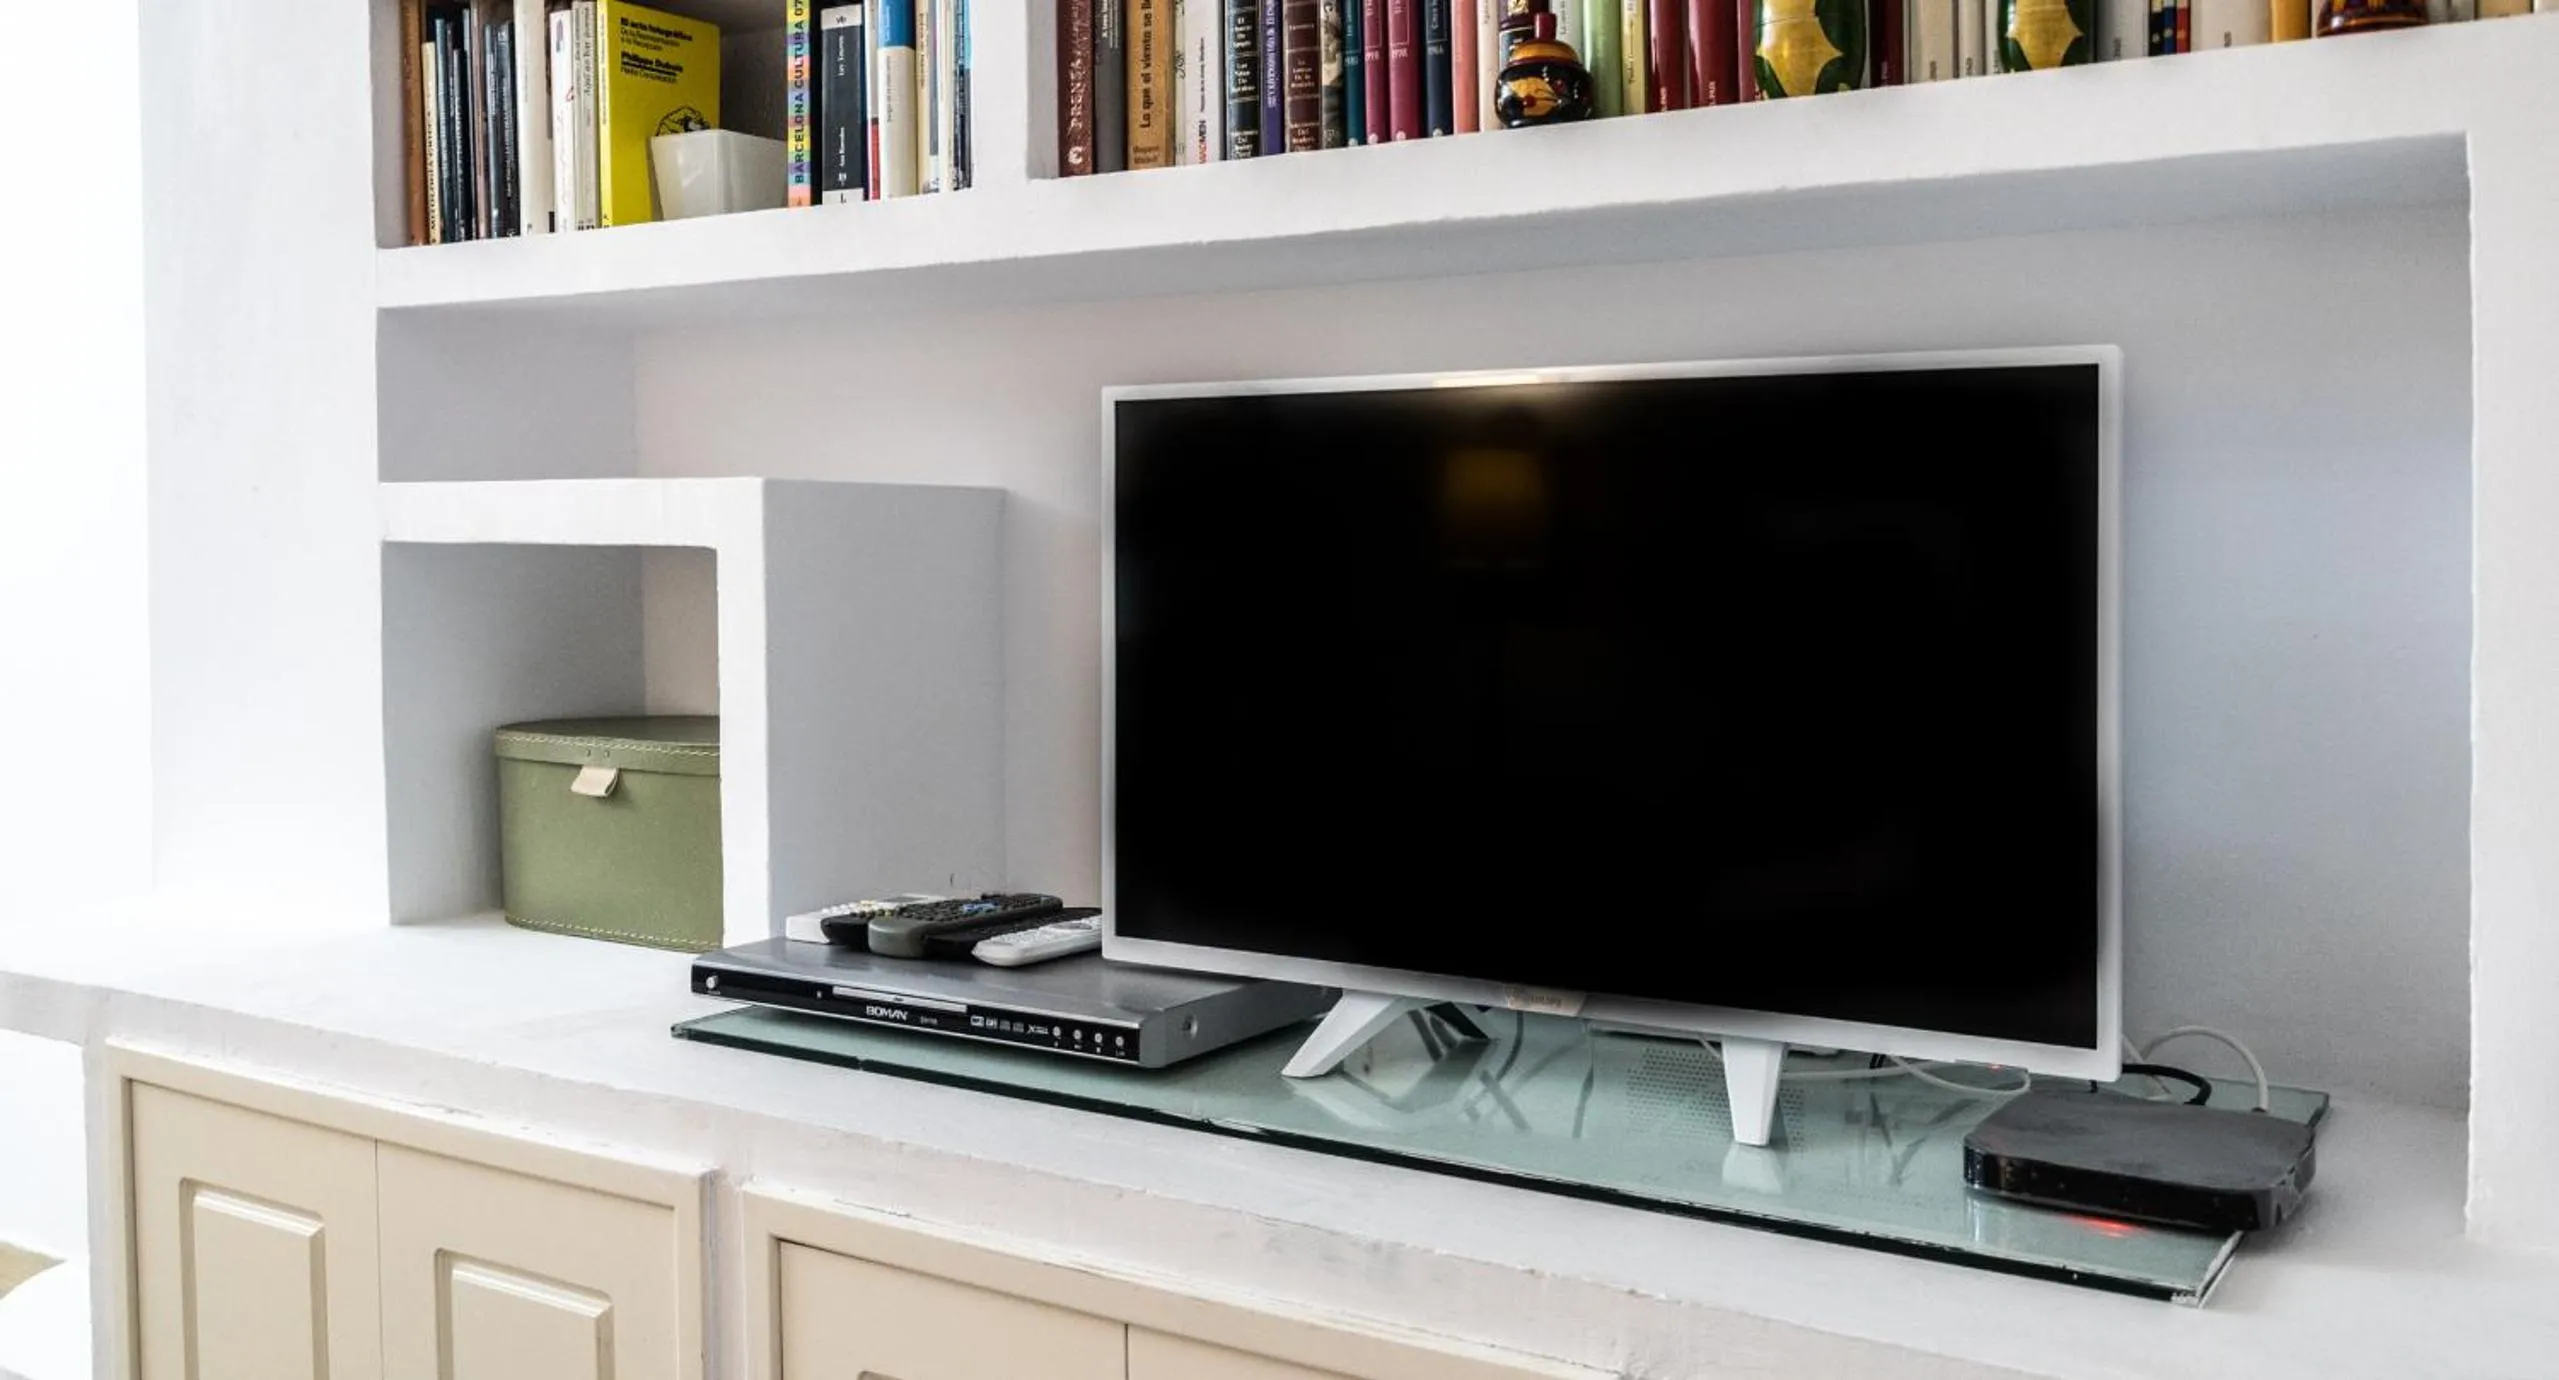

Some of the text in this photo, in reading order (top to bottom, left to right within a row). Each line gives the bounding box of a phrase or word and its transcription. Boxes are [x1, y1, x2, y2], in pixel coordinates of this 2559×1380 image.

[1142, 12, 1152, 26] se
[1139, 31, 1151, 69] viento
[1140, 73, 1151, 84] el
[794, 0, 804, 183] BARCELONA CULTURA 07
[1141, 88, 1153, 110] que
[1140, 113, 1151, 128] Lo
